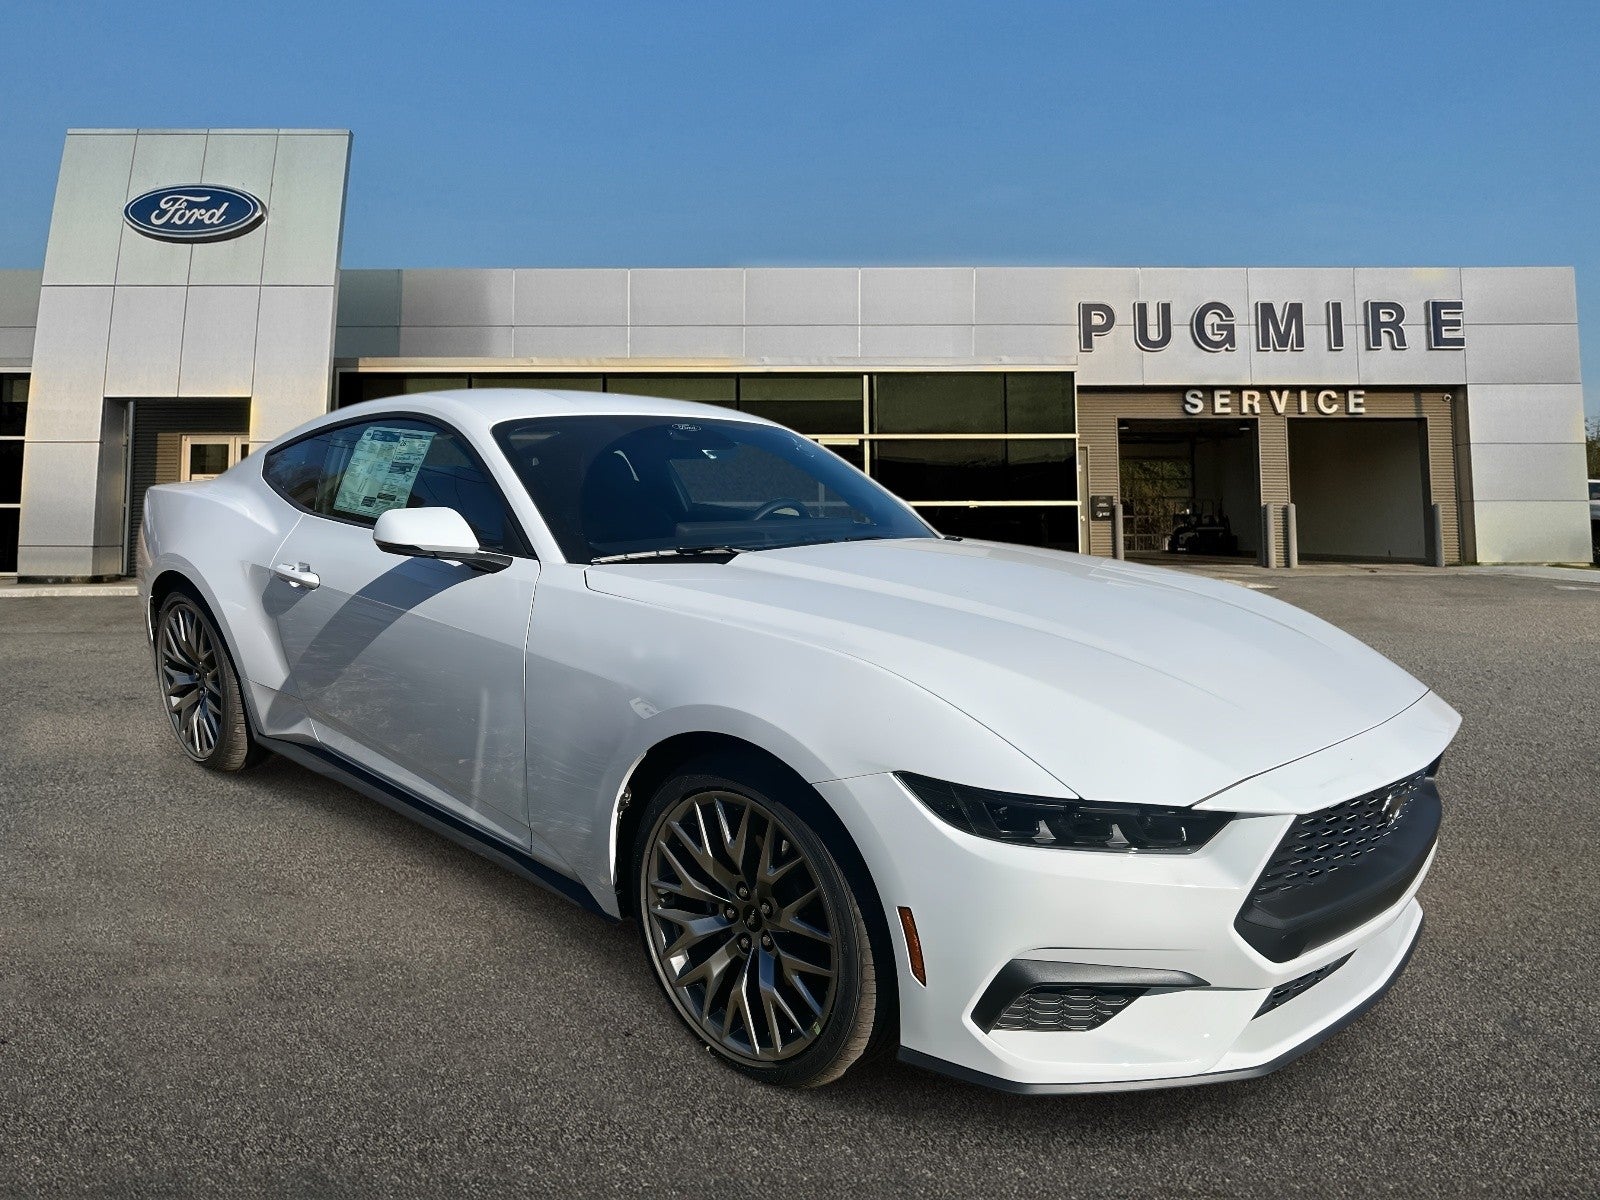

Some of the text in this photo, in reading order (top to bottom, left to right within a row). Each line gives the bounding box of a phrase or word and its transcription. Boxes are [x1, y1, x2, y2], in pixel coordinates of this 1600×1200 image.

[150, 194, 229, 225] Ford
[1078, 299, 1466, 352] PUGMIRE
[1183, 389, 1366, 415] SERVICE
